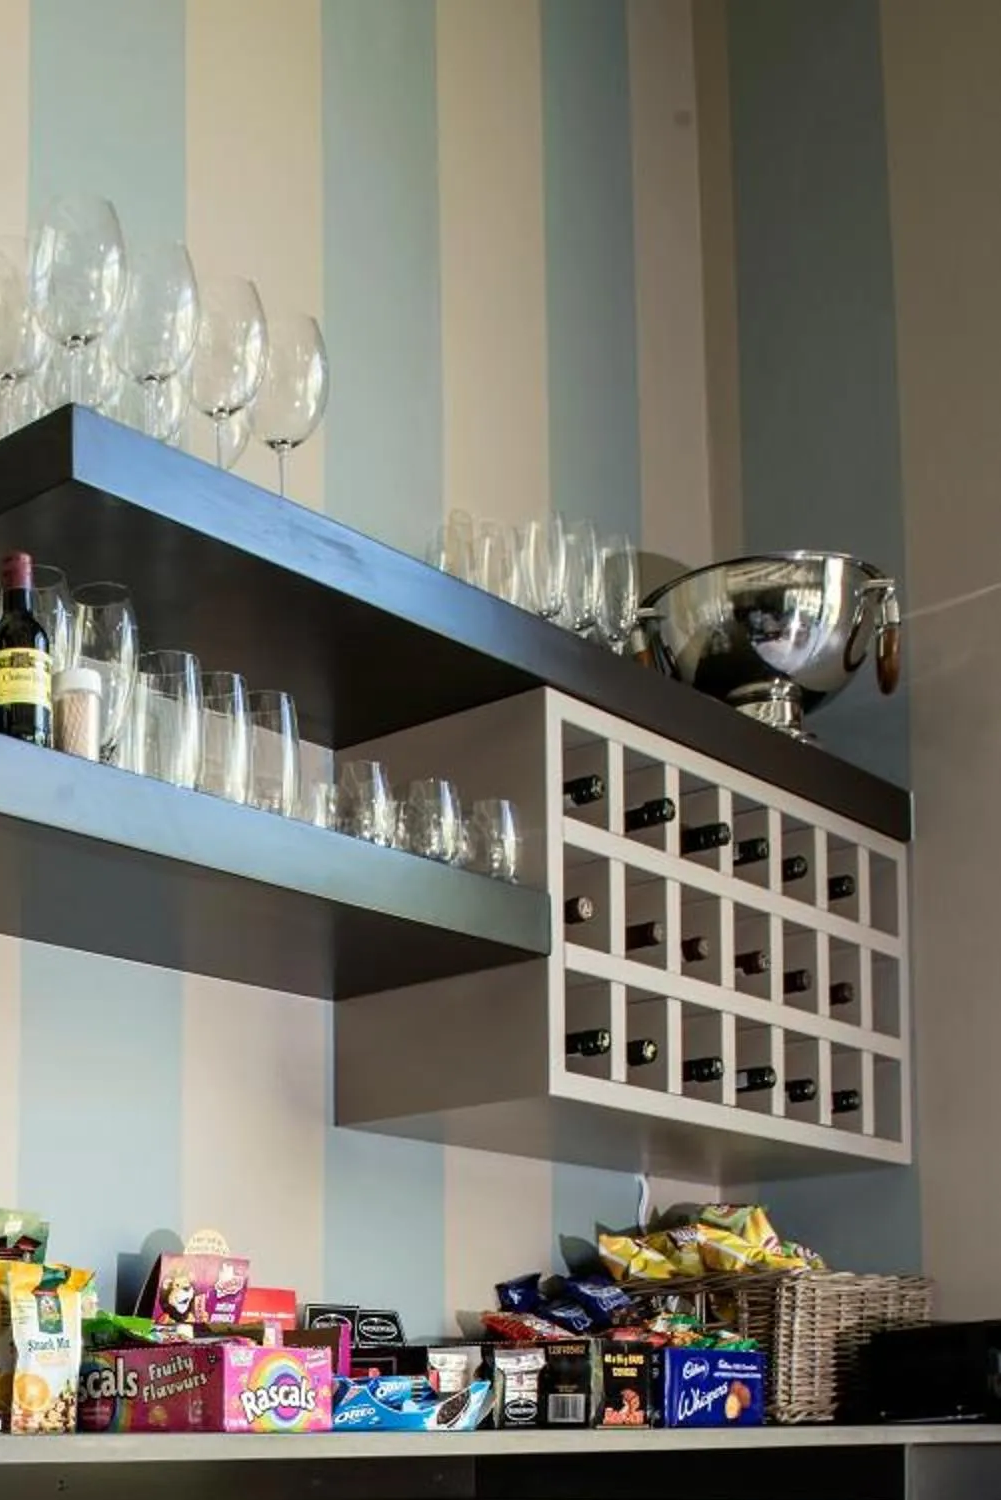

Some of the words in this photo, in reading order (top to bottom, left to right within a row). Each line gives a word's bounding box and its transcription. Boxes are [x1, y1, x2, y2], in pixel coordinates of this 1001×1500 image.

[79, 1357, 138, 1401] scals
[142, 1373, 207, 1403] Flavours
[148, 1356, 194, 1380] Fruity
[240, 1377, 316, 1423] Rascals
[678, 1381, 728, 1421] Whispers
